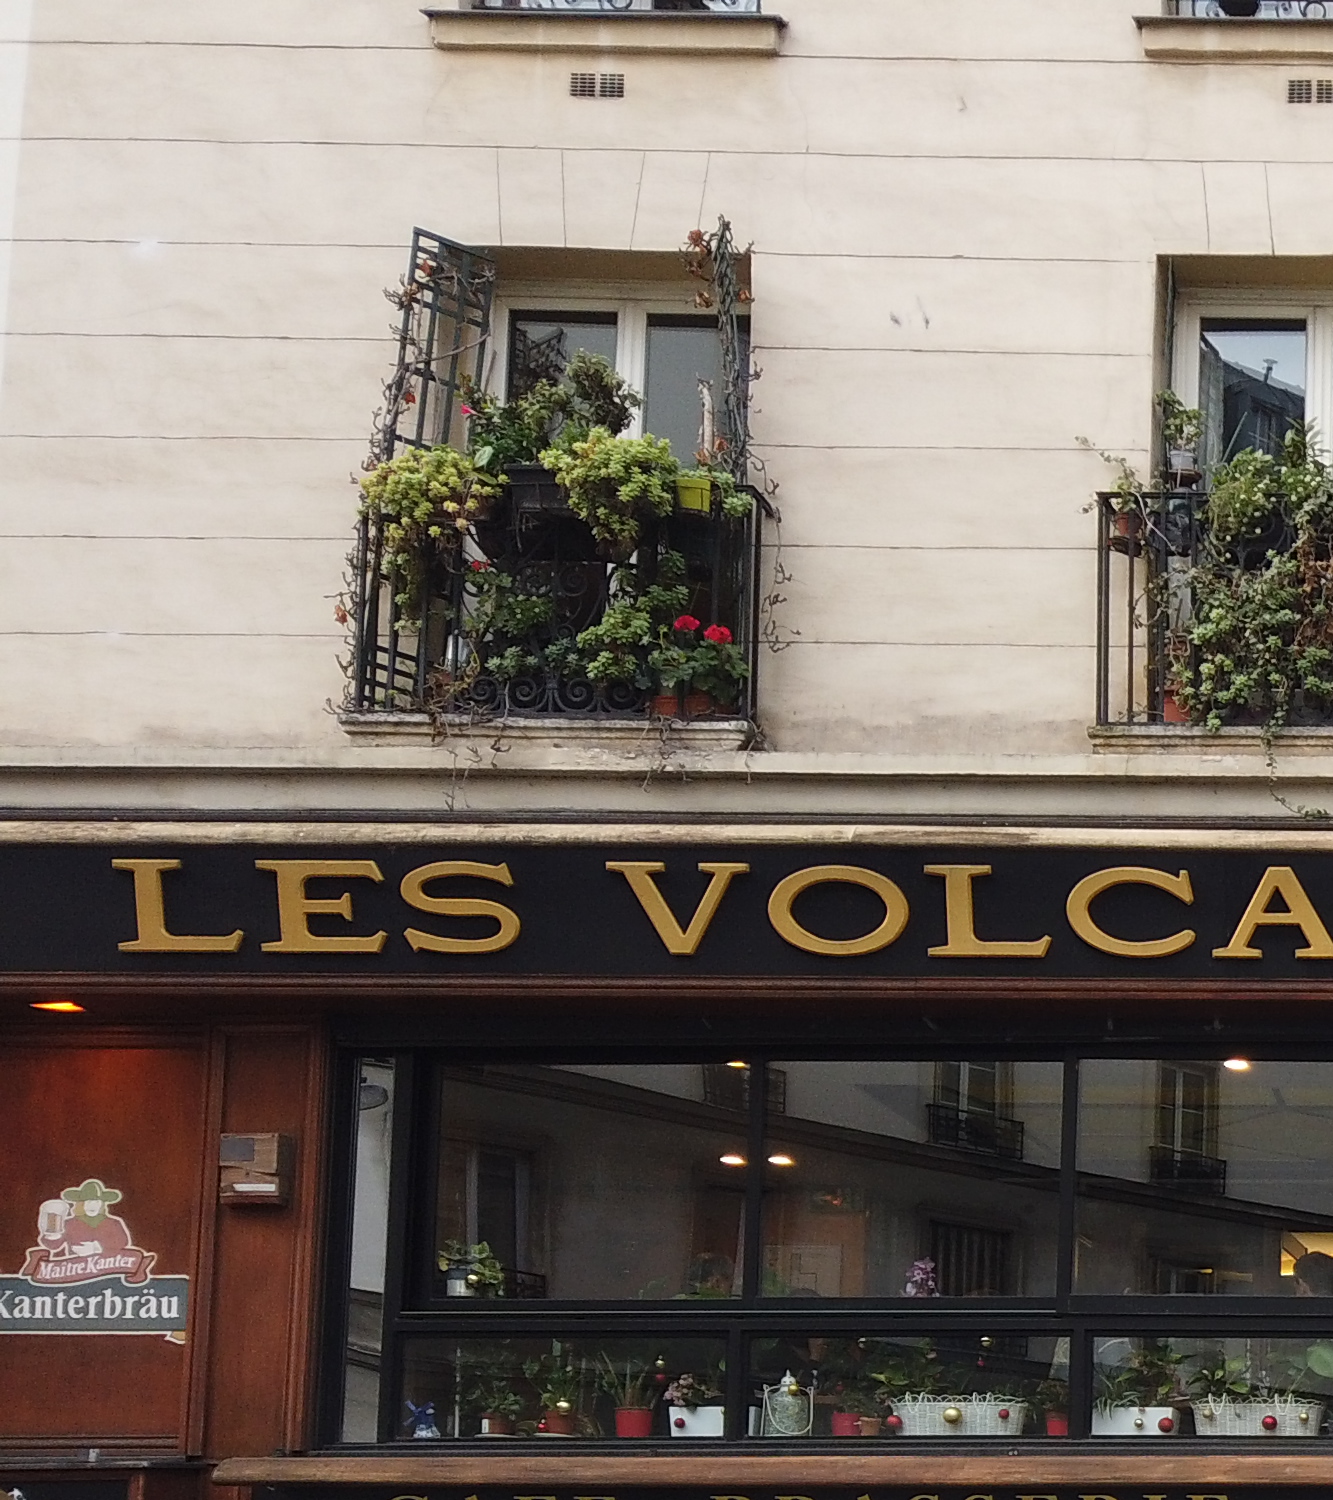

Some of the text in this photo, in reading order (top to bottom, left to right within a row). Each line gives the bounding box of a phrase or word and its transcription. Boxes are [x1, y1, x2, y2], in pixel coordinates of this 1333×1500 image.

[111, 858, 521, 957] LES
[37, 1254, 136, 1280] Maître Kanter
